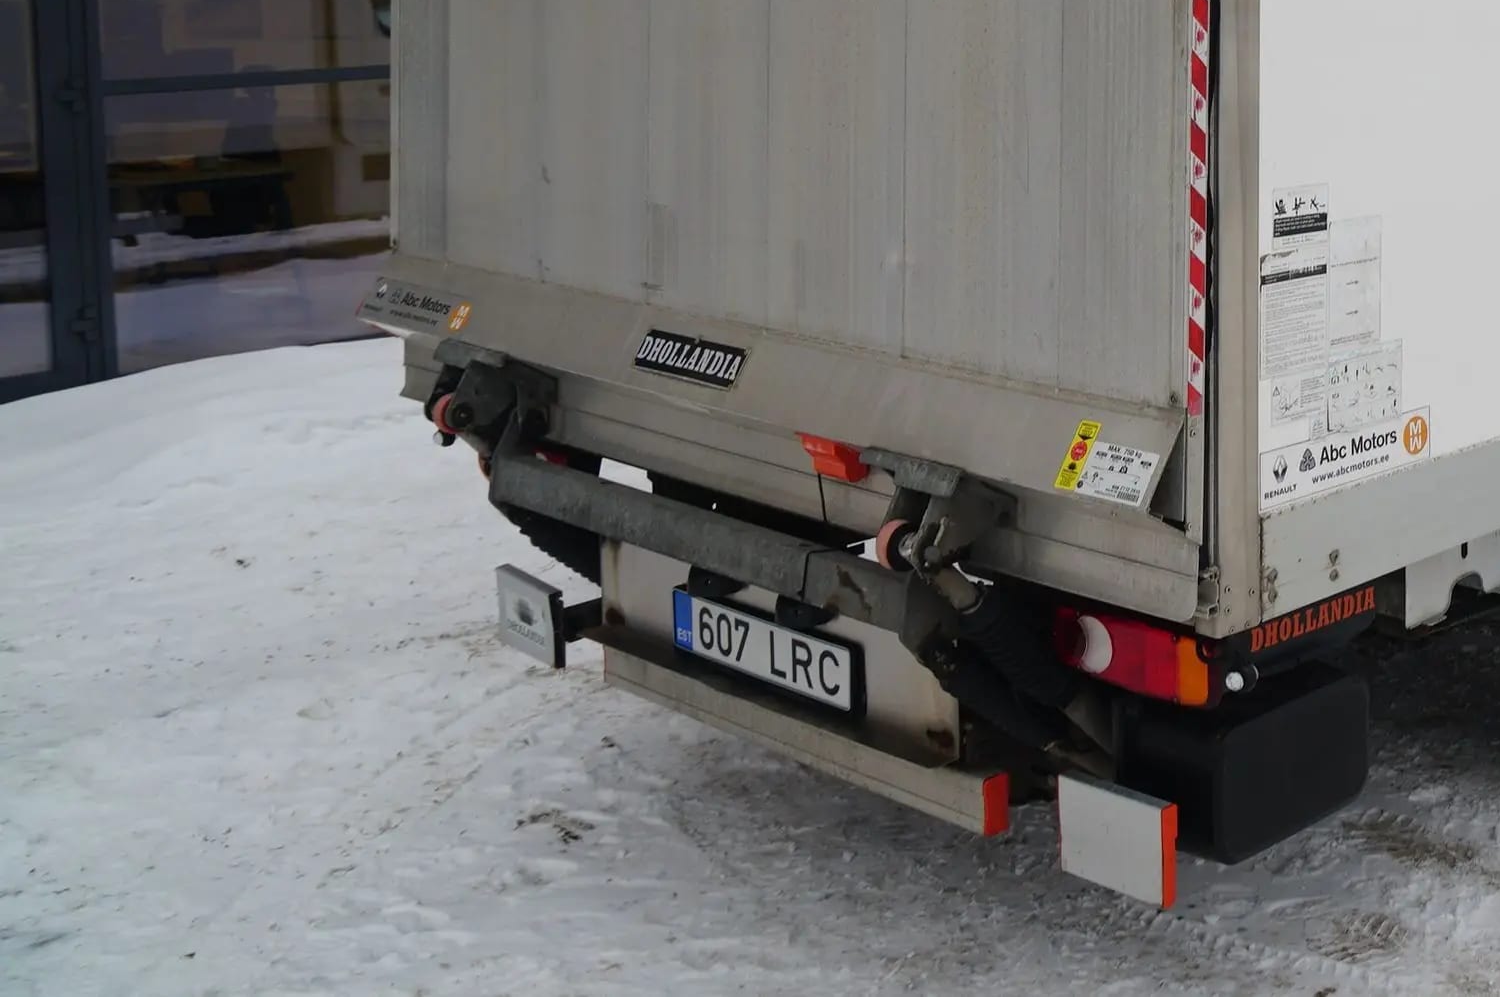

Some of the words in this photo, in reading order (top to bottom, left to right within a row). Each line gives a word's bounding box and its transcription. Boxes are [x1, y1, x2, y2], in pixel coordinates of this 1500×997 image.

[400, 291, 418, 307] Abc
[419, 296, 451, 315] Motors
[637, 336, 742, 381] DHOLLANDIA
[1319, 446, 1347, 466] Abc
[1351, 430, 1397, 456] Motors
[1311, 454, 1390, 485] www.abcmotors.ee
[1264, 484, 1298, 500] RENAULT
[677, 627, 692, 642] EST
[1250, 586, 1376, 653] DHOLLANDIA
[699, 606, 750, 662] 607
[769, 630, 841, 696] LRC
